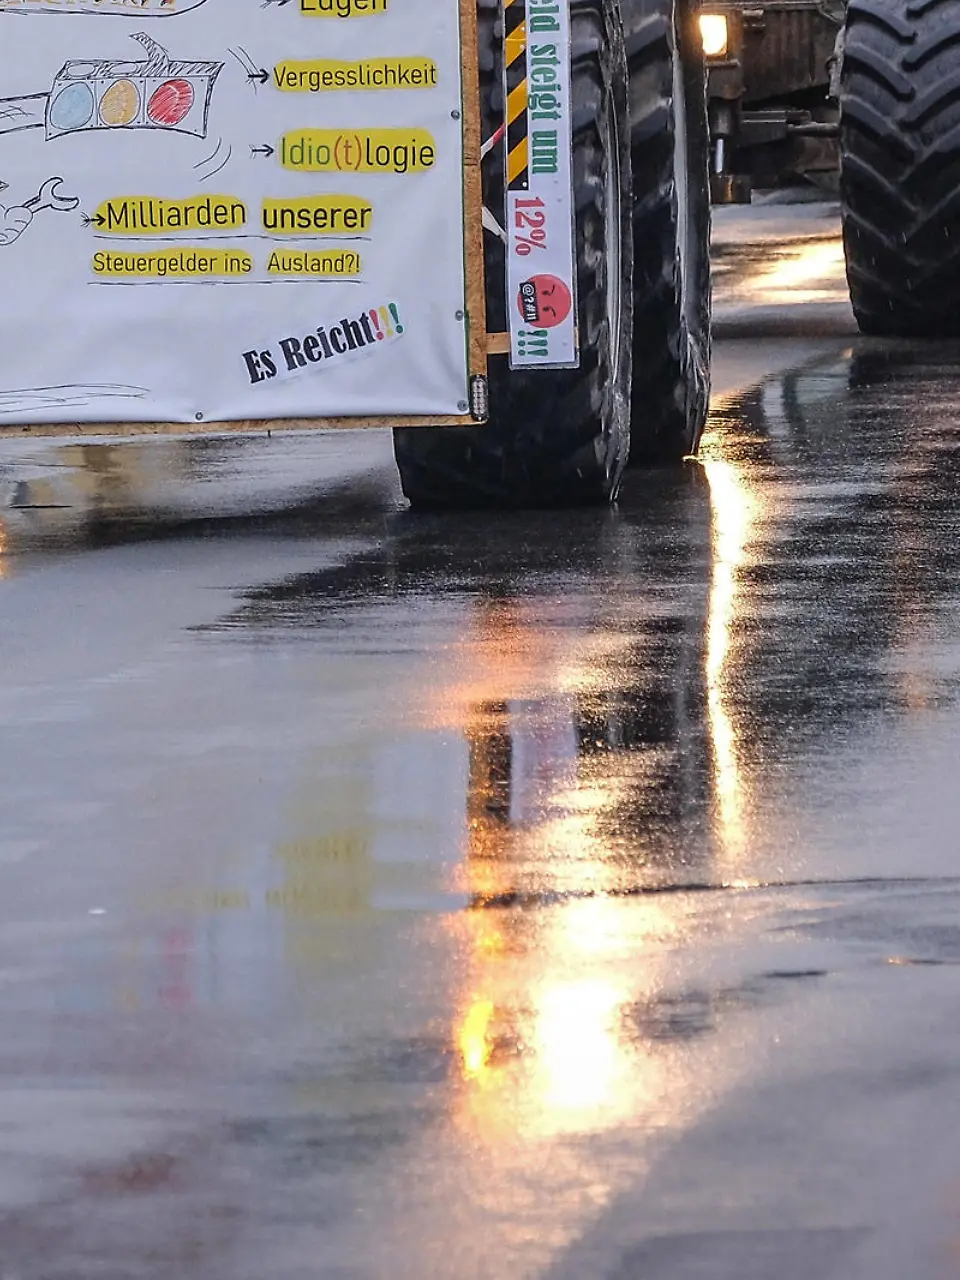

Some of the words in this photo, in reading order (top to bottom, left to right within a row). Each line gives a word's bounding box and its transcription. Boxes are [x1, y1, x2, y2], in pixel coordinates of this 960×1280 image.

[273, 64, 437, 92] Vergesslichkeit
[527, 43, 562, 121] steigt
[281, 135, 435, 174] Idio(t)logie
[532, 129, 558, 175] um
[106, 198, 246, 229] Milliarden
[262, 206, 372, 229] unserer
[515, 196, 548, 256] 12%
[93, 252, 218, 276] Steuergelder
[224, 253, 252, 273] ins
[267, 252, 360, 273] Ausland?!
[242, 349, 278, 384] Es
[278, 302, 404, 371] Reicht!!!
